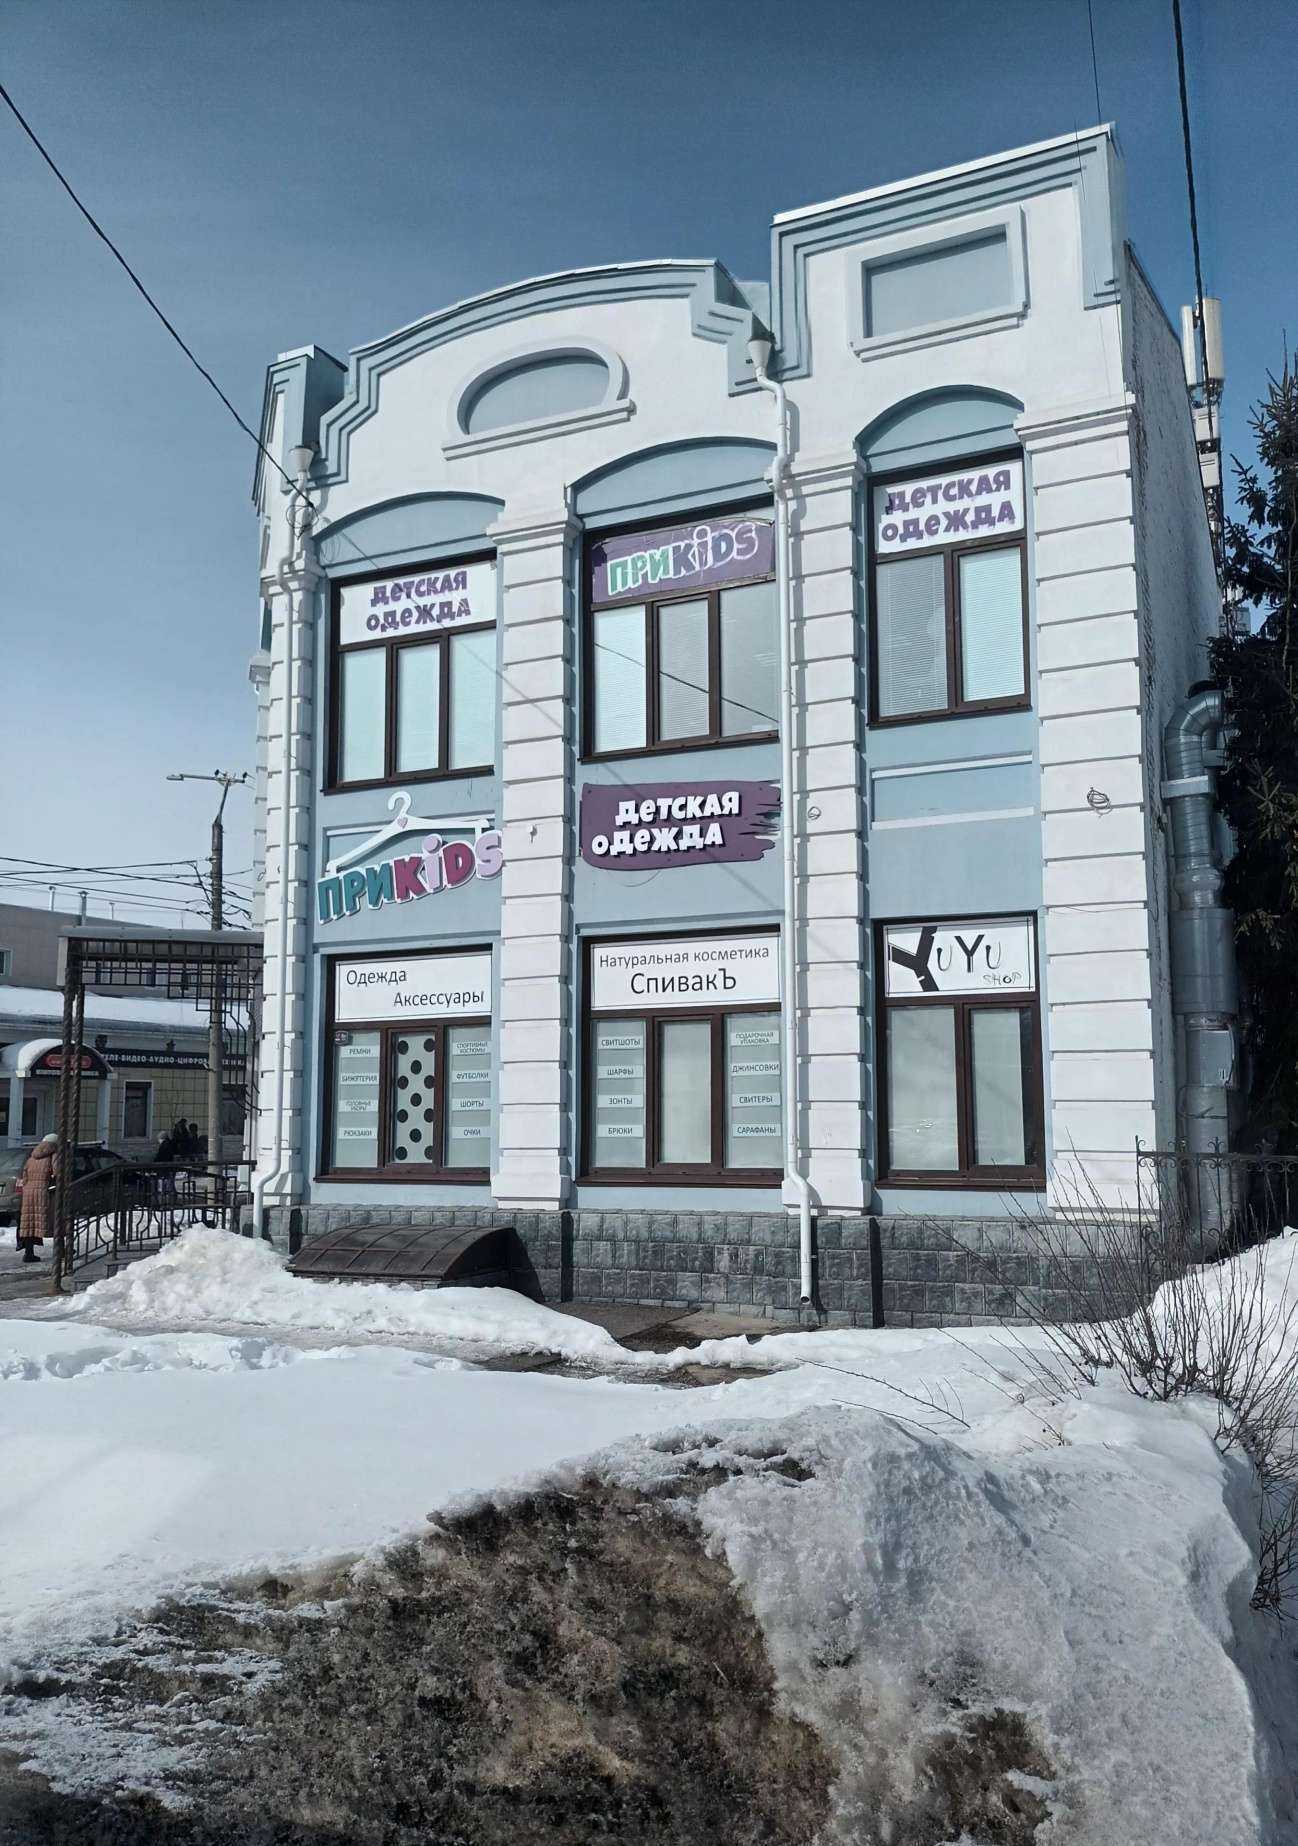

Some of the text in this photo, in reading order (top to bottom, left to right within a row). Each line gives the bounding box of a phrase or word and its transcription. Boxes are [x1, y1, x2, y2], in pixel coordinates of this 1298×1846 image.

[599, 947, 769, 969] Натуральная косметика
[346, 969, 408, 987] Одежда
[630, 968, 737, 995] СпивакЪ
[393, 990, 485, 1008] Аксессуары
[601, 1038, 641, 1046] СВИТШОТЫ
[607, 1068, 634, 1076] ШАРФЫ
[732, 1064, 779, 1073] ДЖИНСОВКИ
[456, 1072, 489, 1080] ФУТБОЛКИ
[608, 1097, 633, 1105] ЗОНТЫ
[739, 1095, 773, 1103] СВИТЕРЫ
[608, 1127, 633, 1135] БРЮКИ
[737, 1126, 776, 1134] САРАФАНЫ
